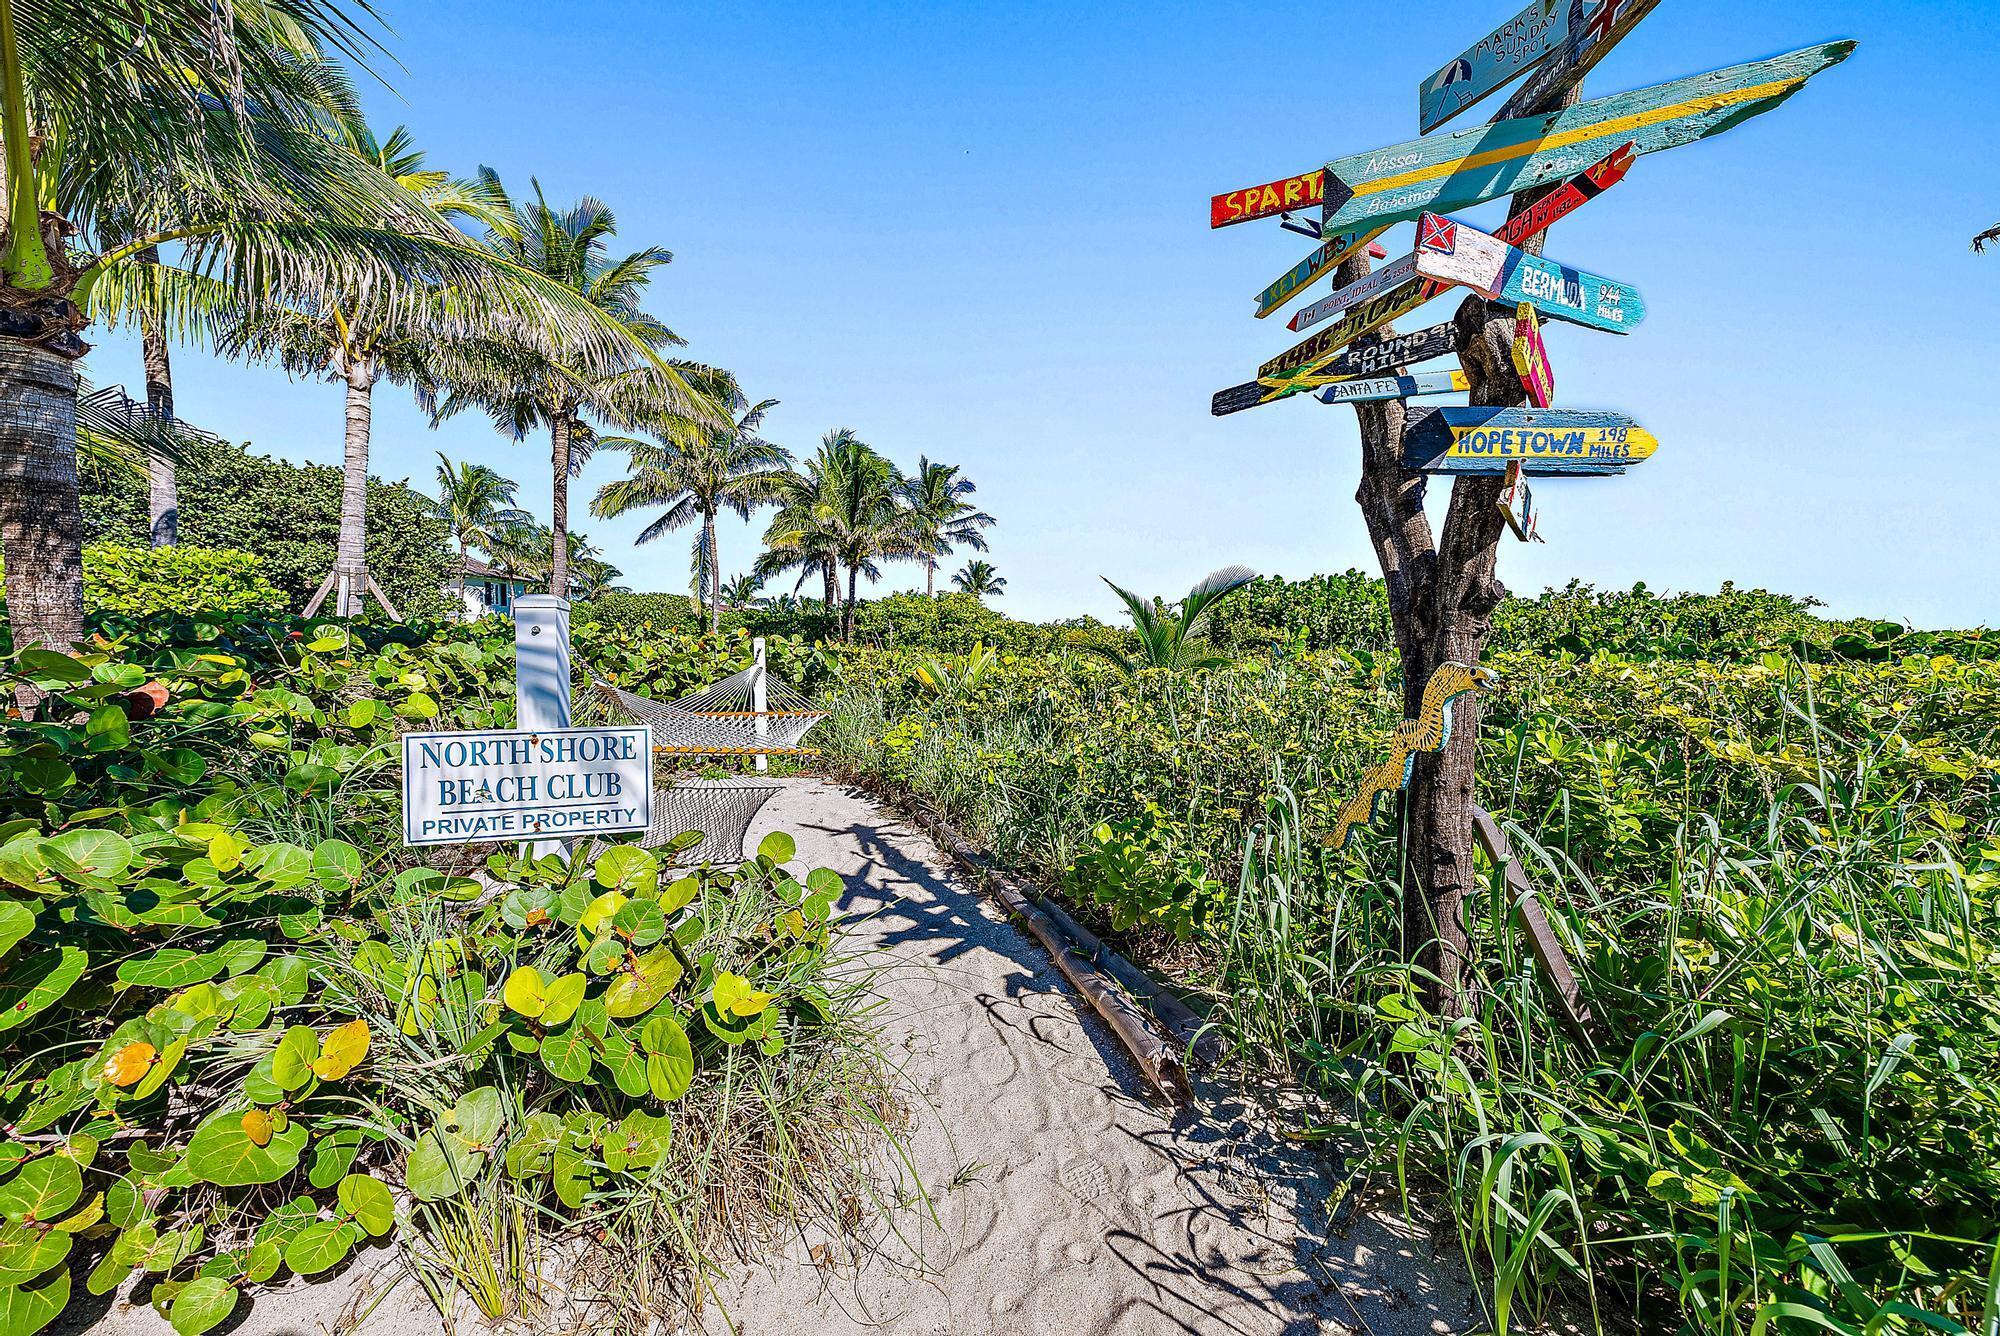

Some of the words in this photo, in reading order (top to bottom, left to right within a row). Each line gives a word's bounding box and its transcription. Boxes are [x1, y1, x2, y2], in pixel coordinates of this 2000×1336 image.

[1475, 6, 1539, 61] MARK'S
[1495, 10, 1559, 62] SUNDAY
[1513, 32, 1548, 64] SPOT
[1366, 186, 1441, 214] Bahamas
[1537, 186, 1569, 212] SPRINGS
[1537, 208, 1549, 224] NY
[1269, 269, 1299, 302] KEY
[1350, 280, 1378, 299] IDEAL
[1521, 265, 1587, 312] BERMUDA
[1600, 284, 1621, 305] 944
[1597, 304, 1624, 323] MILES
[1348, 331, 1428, 367] ROUND
[1361, 349, 1419, 374] HILL
[1334, 382, 1373, 398] SANTA
[1374, 380, 1394, 393] FE
[1599, 427, 1628, 442] 198
[1589, 444, 1631, 457] MILES
[419, 739, 531, 769] NORTH
[540, 735, 638, 764] SHORE
[438, 775, 538, 806] BEACH
[546, 772, 622, 799] CLUB
[422, 815, 515, 836] PRIVATE
[522, 808, 638, 829] PROPERTY
